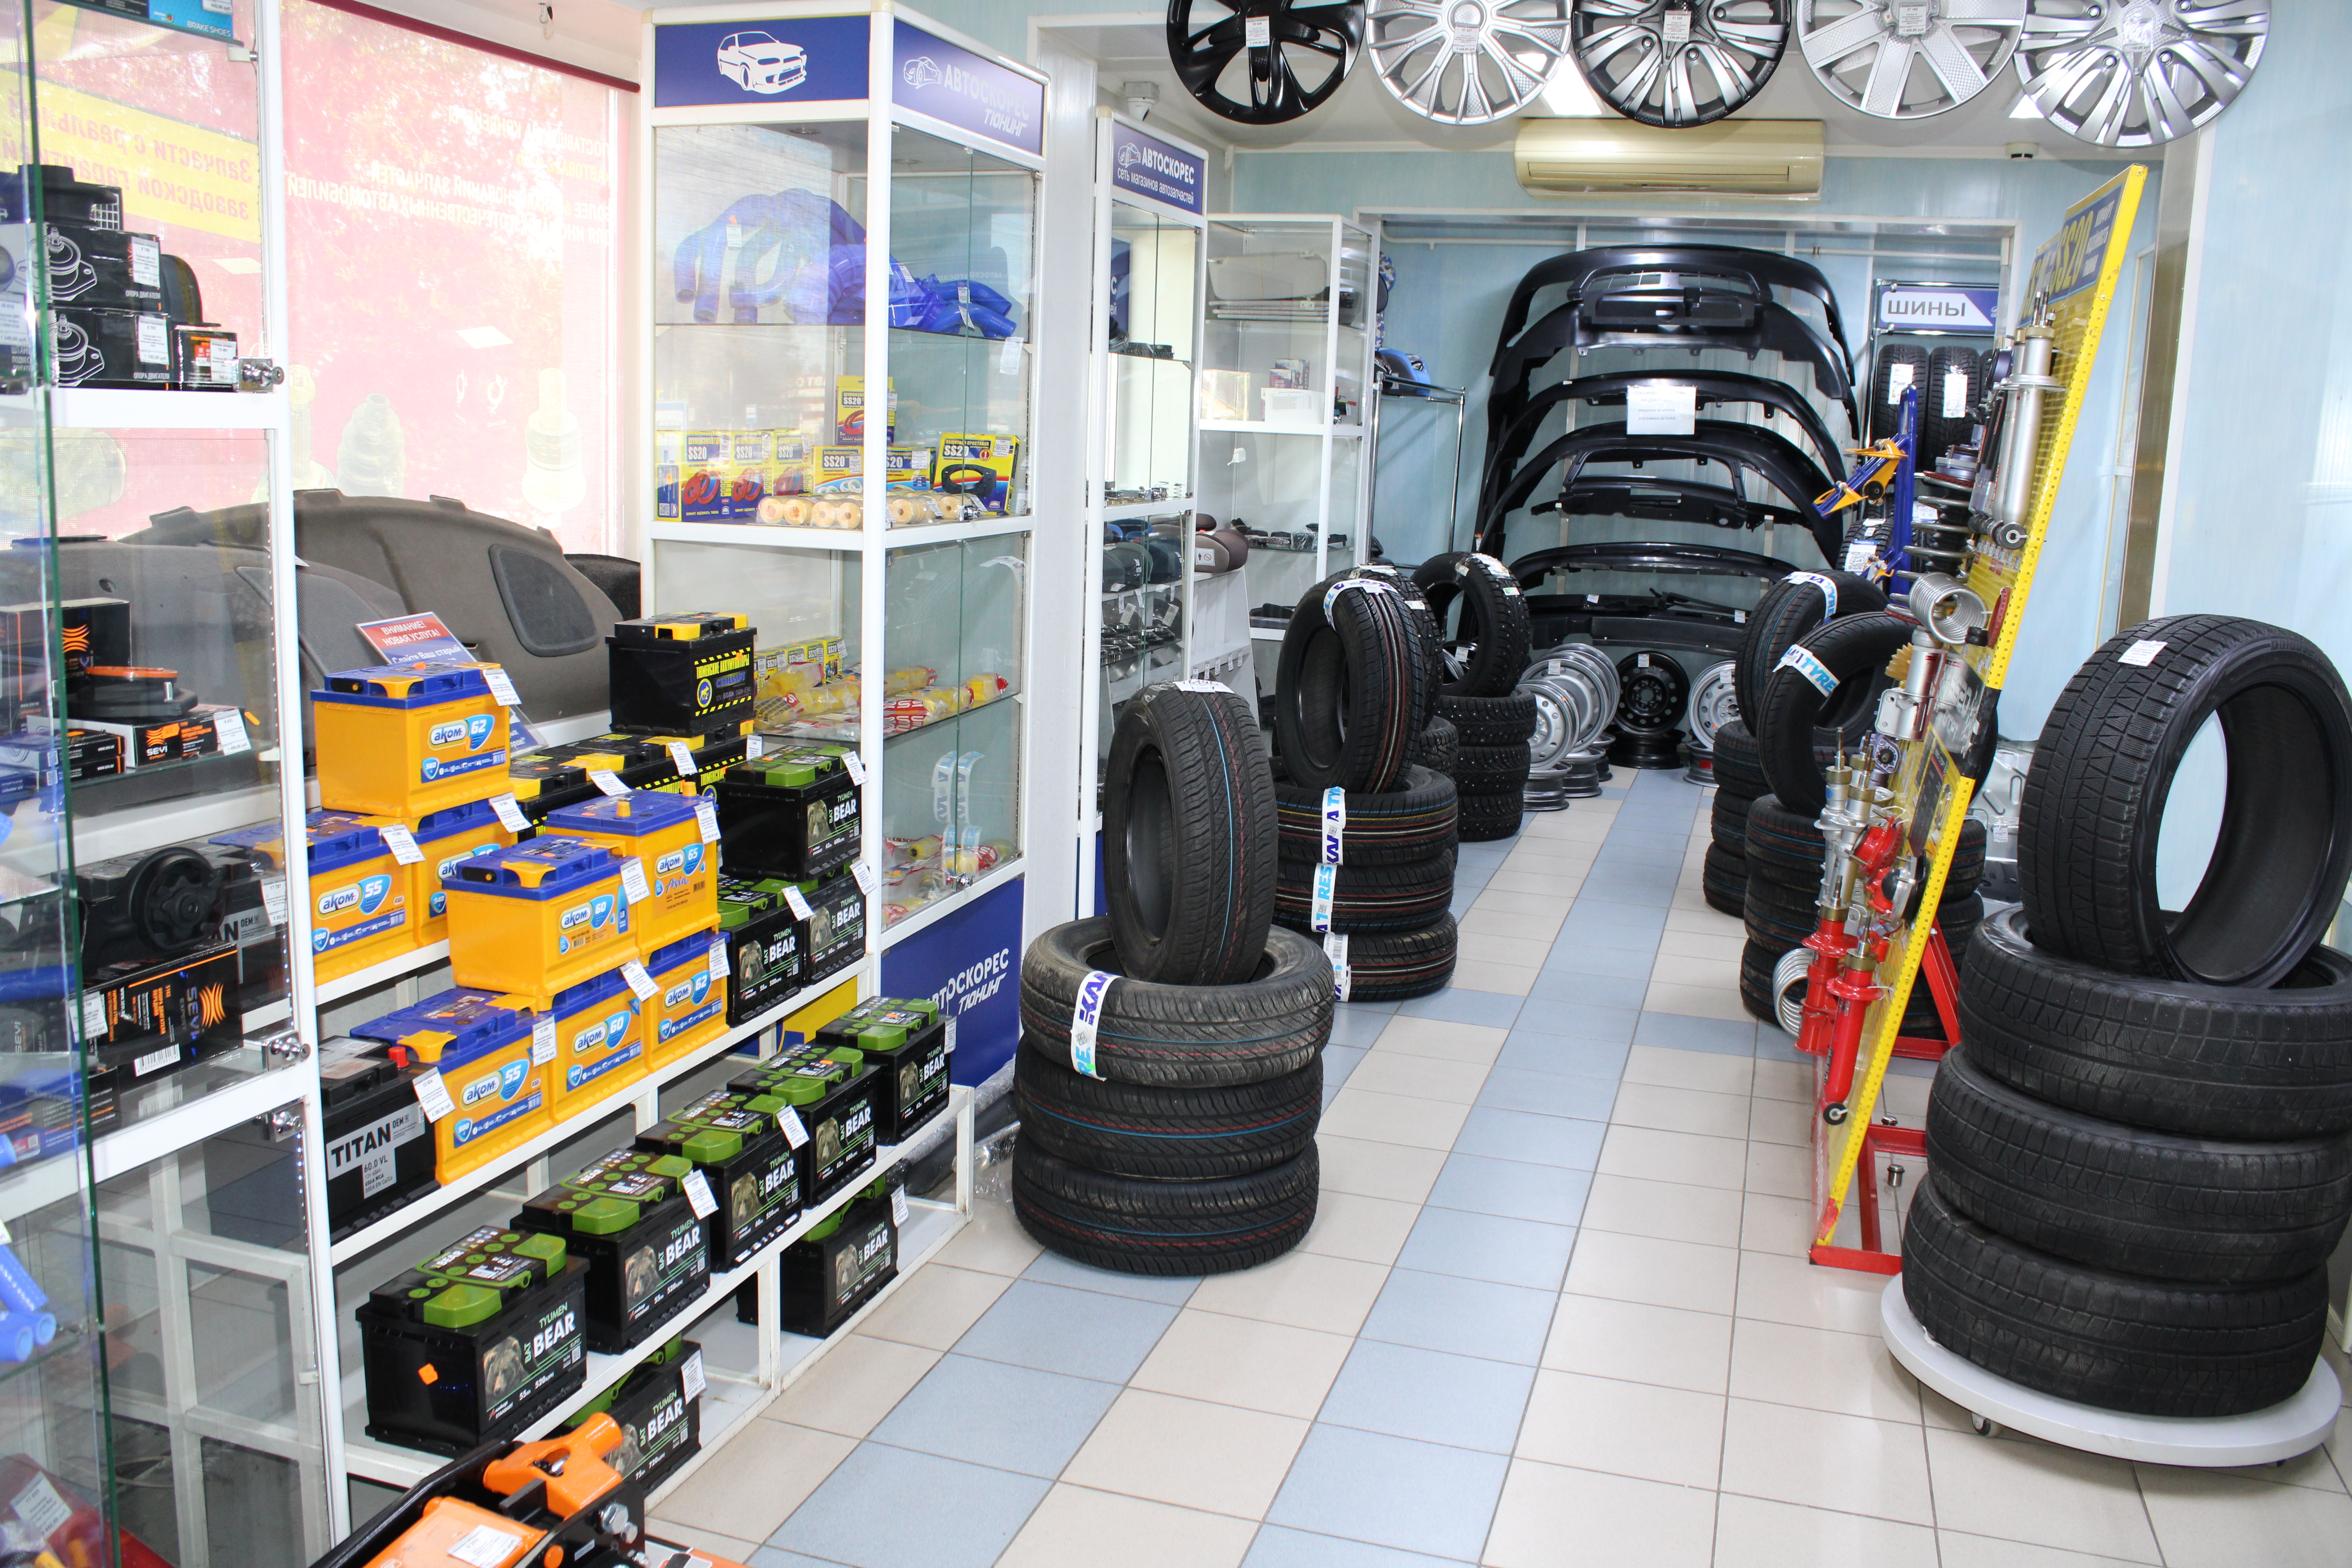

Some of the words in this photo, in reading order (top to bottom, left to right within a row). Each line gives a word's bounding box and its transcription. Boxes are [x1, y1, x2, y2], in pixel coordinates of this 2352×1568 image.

[187, 21, 209, 33] BRAKE
[209, 26, 231, 37] SHOES
[944, 64, 1030, 120] АВТОСКОРЕС
[1142, 147, 1195, 185] АВТОСКОРЕС
[1118, 167, 1130, 181] сеть
[1131, 172, 1158, 192] магазинов
[1159, 182, 1194, 205] автозапчастей
[1887, 299, 1966, 317] ШИНЫ
[843, 397, 862, 405] SS20
[688, 446, 707, 460] SS20
[736, 446, 752, 458] SS20
[778, 446, 793, 458] SS20
[944, 445, 970, 457] SS20
[824, 456, 845, 468] SS20
[381, 620, 426, 635] ВНИМАНИЕ!
[382, 633, 411, 646] НОВАЯ
[410, 628, 441, 642] УСЛУГА!
[421, 648, 436, 659] Ваш
[436, 645, 461, 659] старый
[828, 644, 838, 654] SS20
[696, 661, 720, 679] ТЮМЕНСКИЕ
[720, 653, 750, 673] АККУМУЛЯТОРЫ
[766, 659, 777, 667] SS20
[472, 719, 486, 734] 62
[837, 789, 853, 803] TYUMEN
[833, 798, 857, 822] BEAR
[688, 847, 699, 860] 65
[365, 880, 383, 898] 55
[666, 877, 688, 893] Asia
[595, 903, 607, 915] 60
[840, 894, 857, 908] TYUMEN
[241, 915, 253, 928] OEM
[837, 901, 861, 927] BEAR
[773, 927, 791, 942] TYUMEN
[769, 935, 796, 962] BEAR
[695, 977, 707, 991] 62
[186, 986, 200, 1037] SEVI
[610, 1018, 624, 1034] 60
[927, 1045, 942, 1061] TYUMEN
[505, 1065, 521, 1085] 55
[923, 1053, 945, 1081] BEAR
[689, 1107, 708, 1118] BEAR
[849, 1098, 867, 1116] TYUMEN
[845, 1105, 871, 1138] BEAR
[331, 1122, 392, 1168] TITAN
[392, 1118, 404, 1129] OEM
[364, 1159, 378, 1172] 60.0
[379, 1155, 388, 1165] VL
[769, 1150, 789, 1170] TYUMEN
[581, 1167, 605, 1183] BEAR
[765, 1158, 795, 1194] BEAR
[671, 1217, 695, 1240] TYUMEN
[867, 1221, 884, 1238] TYUMEN
[666, 1225, 701, 1267] BEAR
[863, 1228, 888, 1262] BEAR
[438, 1250, 465, 1267] BEAR
[696, 1249, 705, 1259] EURO
[539, 1302, 568, 1329] TYUMEN
[533, 1310, 576, 1359] BEAR
[570, 1338, 581, 1349] EURO
[652, 1388, 677, 1416] TYUMEN
[647, 1397, 684, 1441] BEAR
[679, 1419, 688, 1430] EURO
